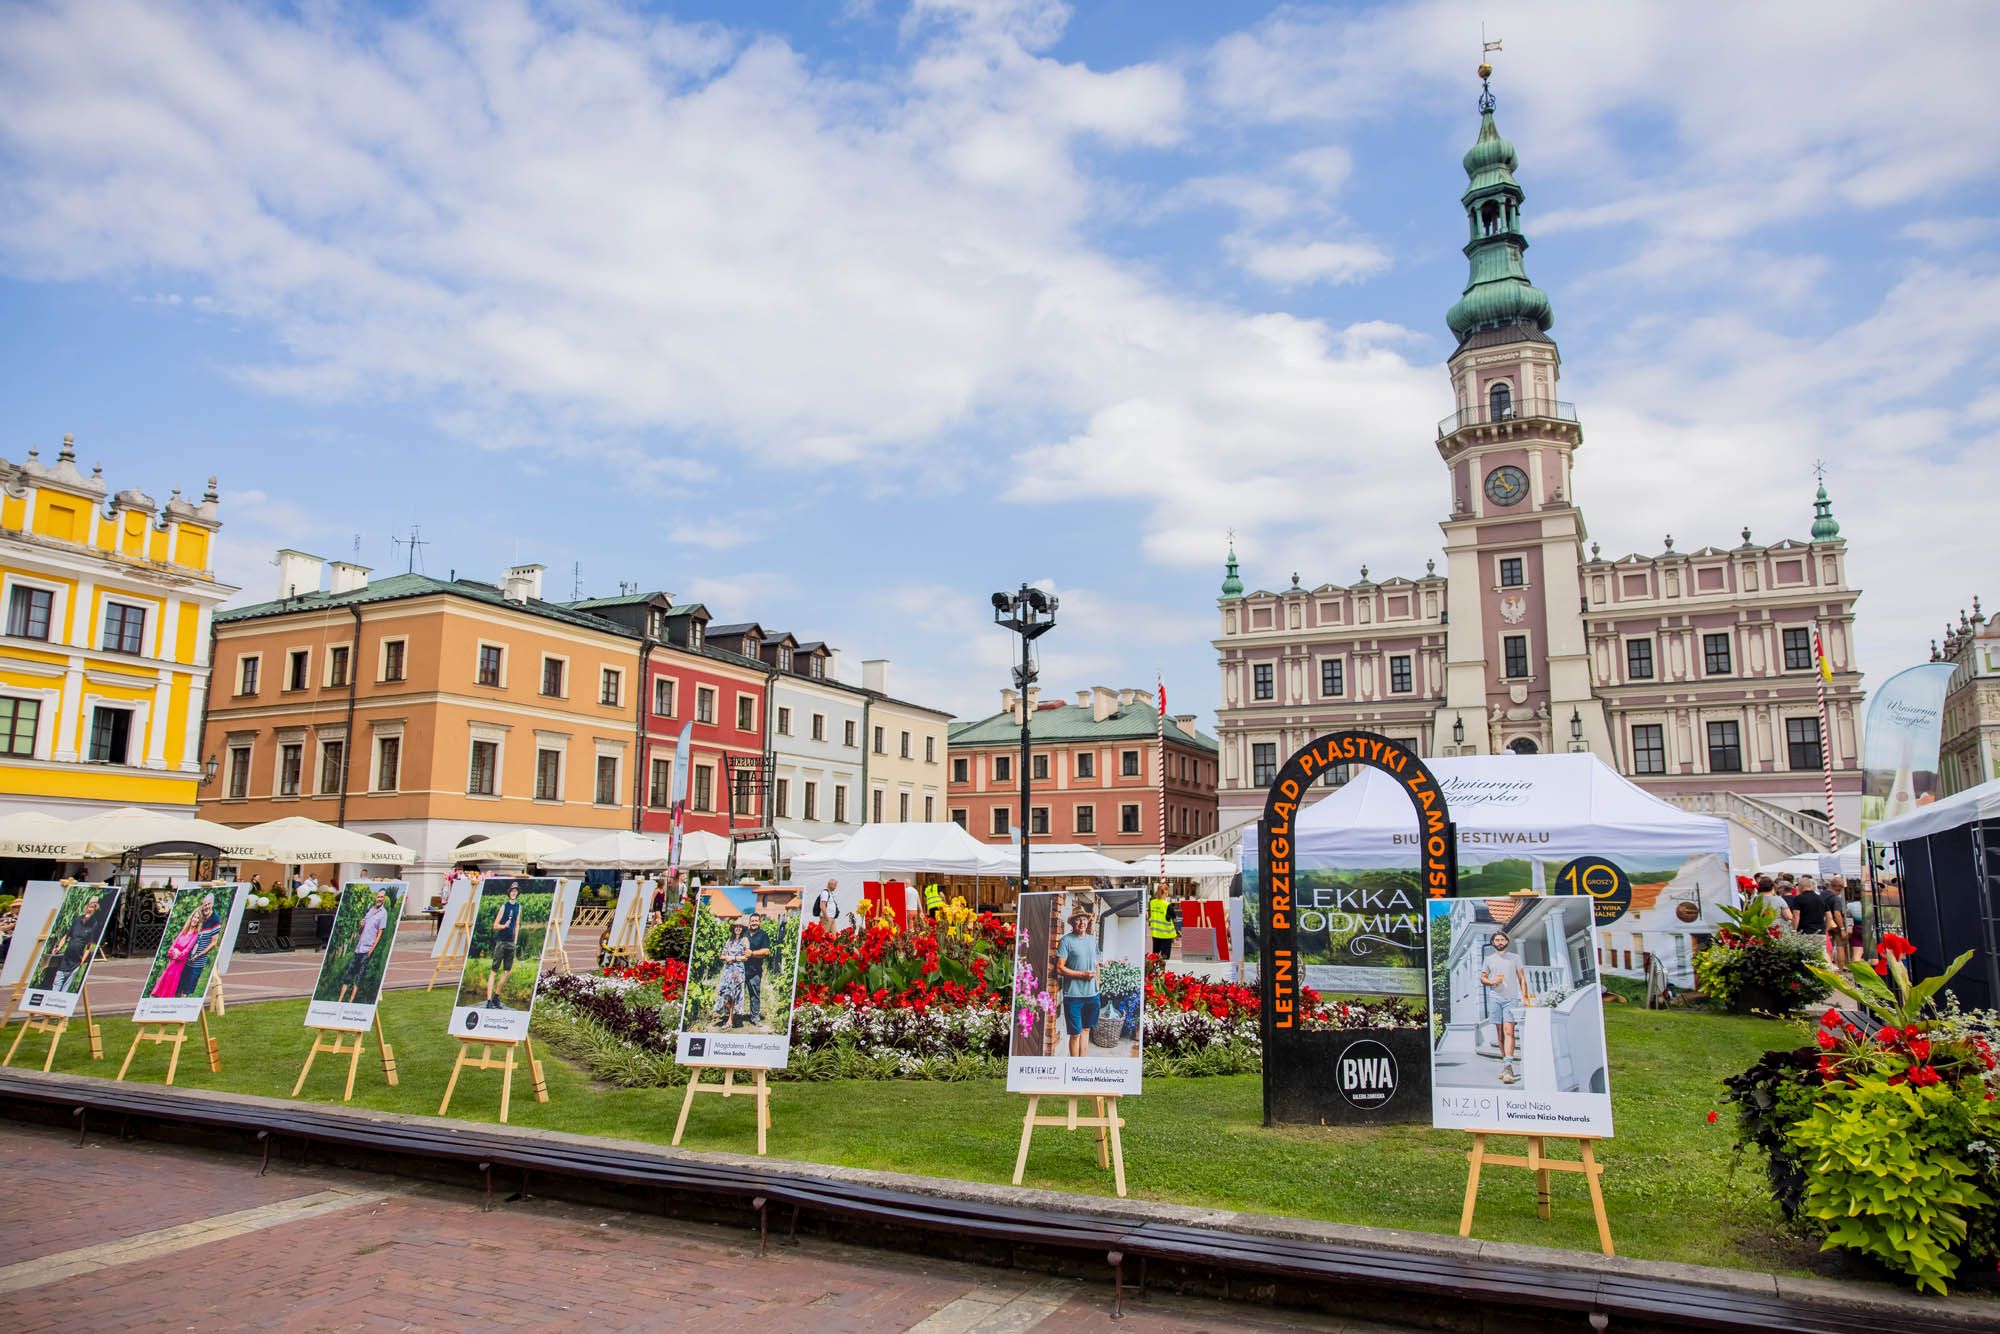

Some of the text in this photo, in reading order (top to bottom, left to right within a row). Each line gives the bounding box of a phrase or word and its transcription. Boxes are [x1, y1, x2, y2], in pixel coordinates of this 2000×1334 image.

[1392, 832, 1419, 845] BIU
[16, 842, 67, 856] KSIĄŻĘCE
[221, 846, 255, 856] IĄŻĘCE
[1271, 737, 1447, 1029] LETNI PRZEGLĄD PLASTYKI ZAMOJSK
[1564, 864, 1619, 899] 10
[1295, 887, 1414, 909] LEKKA
[714, 1041, 745, 1050] Magdalena
[1019, 1066, 1057, 1075] MICKIEWICZ
[1072, 1066, 1129, 1076] Maciej Mickiewicz
[1343, 1057, 1394, 1090] BWA
[1442, 1097, 1492, 1110] NIZIO
[1506, 1100, 1551, 1111] Karol Nizio
[1506, 1112, 1591, 1123] Winnica Nizio Naturals
